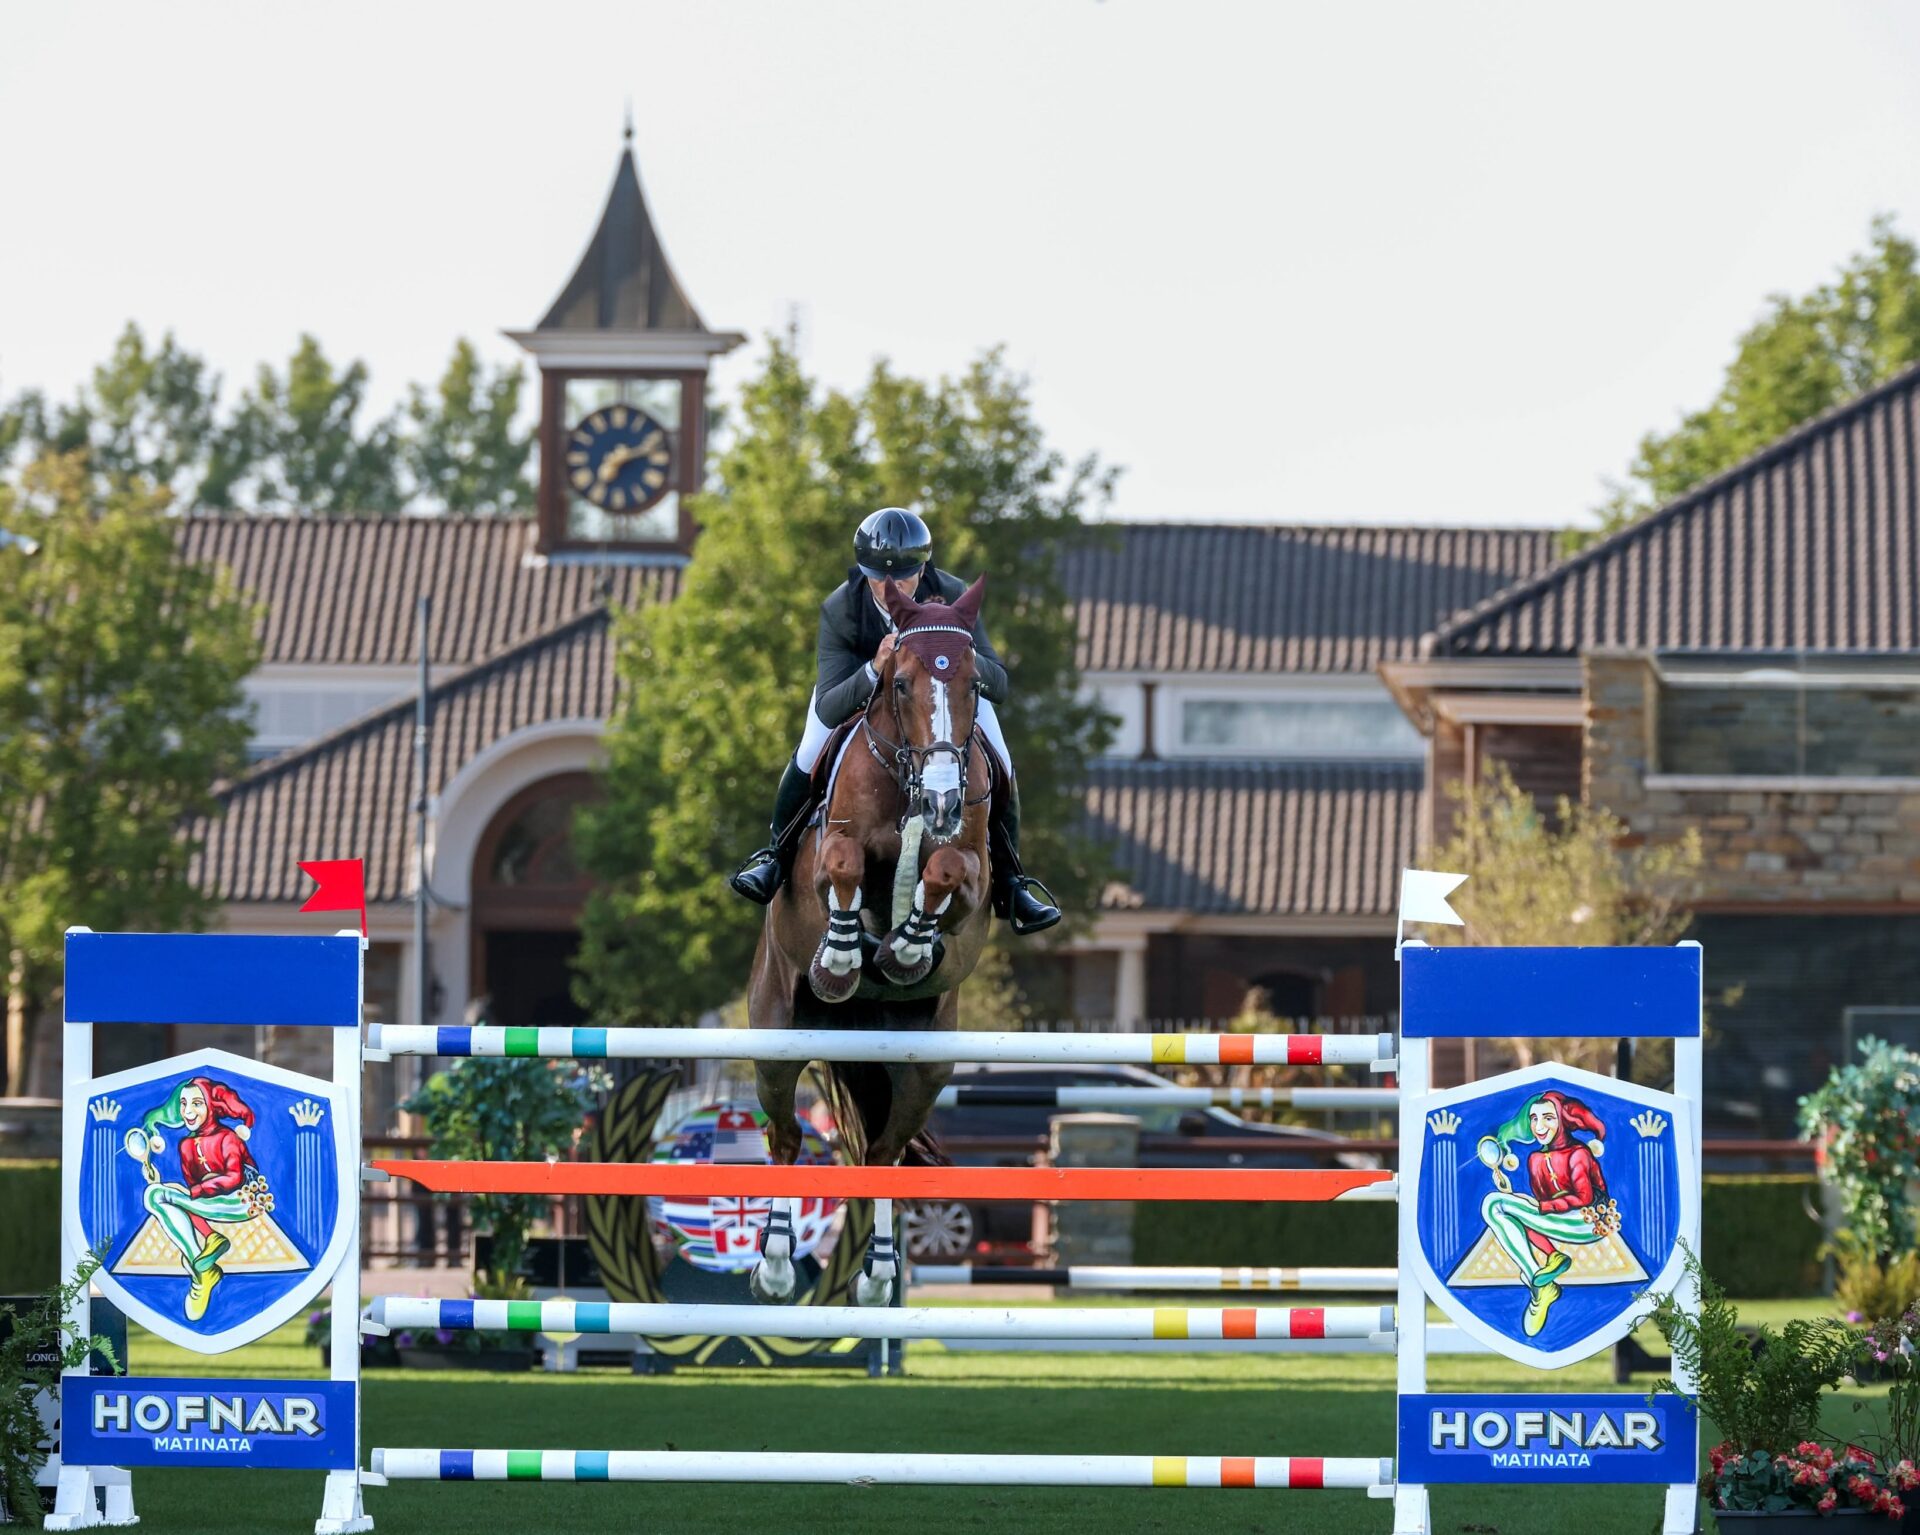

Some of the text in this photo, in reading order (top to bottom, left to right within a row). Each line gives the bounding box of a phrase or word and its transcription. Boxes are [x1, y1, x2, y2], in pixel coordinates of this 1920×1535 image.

[94, 1394, 325, 1436] HOFNAR
[154, 1437, 252, 1452] MATINATA
[1431, 1410, 1665, 1451] HOFNAR
[1493, 1453, 1591, 1468] MATINATA
